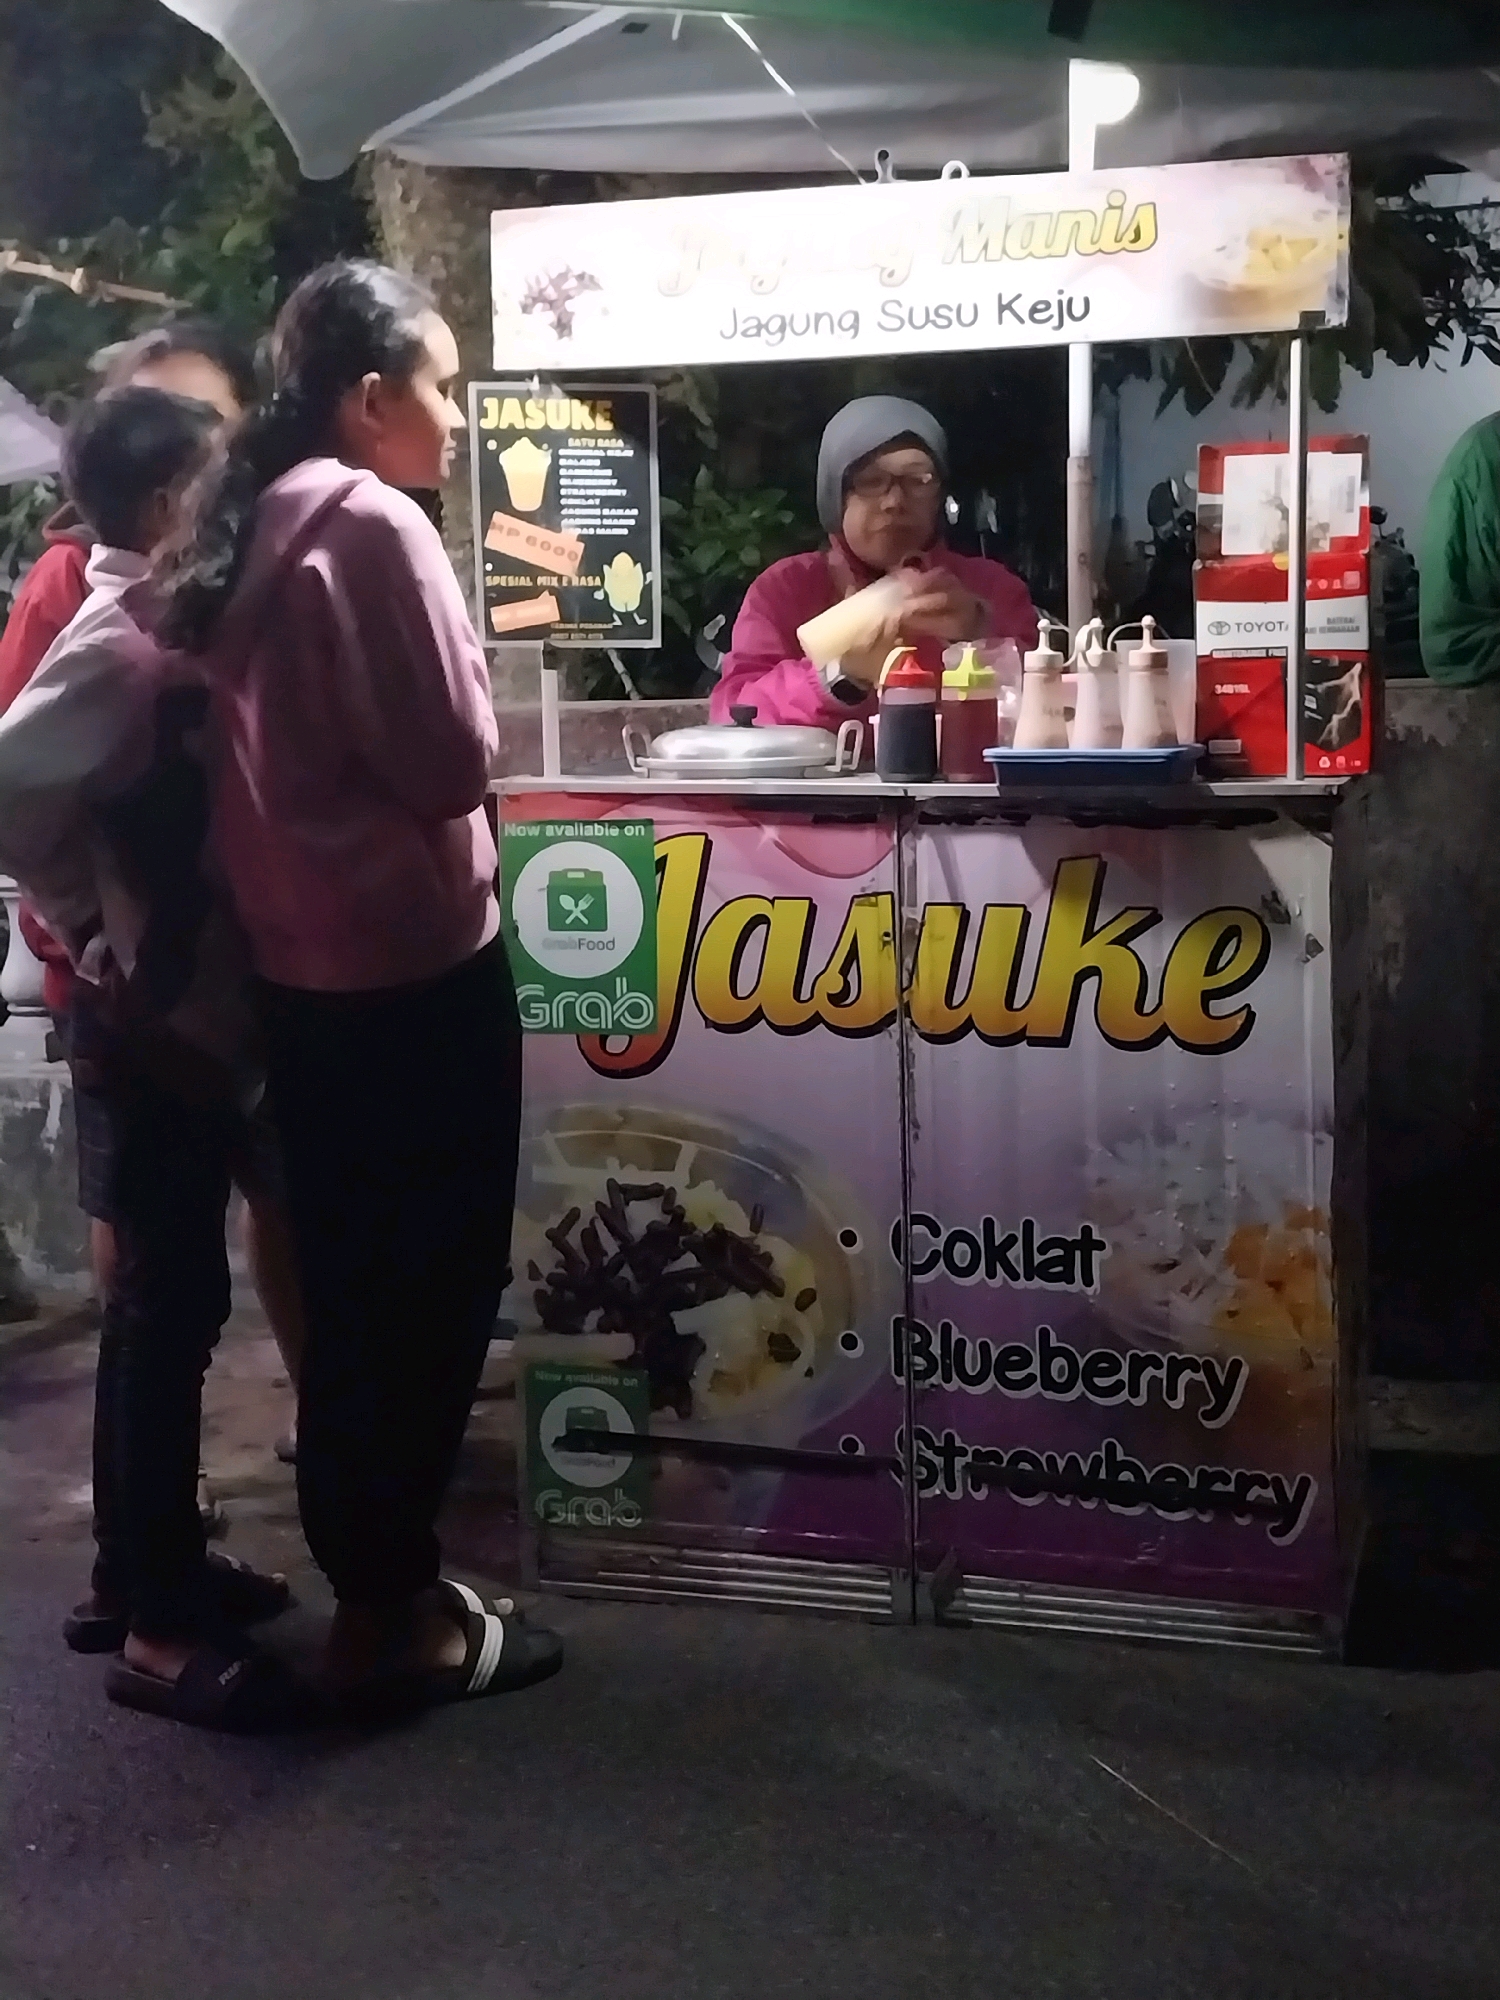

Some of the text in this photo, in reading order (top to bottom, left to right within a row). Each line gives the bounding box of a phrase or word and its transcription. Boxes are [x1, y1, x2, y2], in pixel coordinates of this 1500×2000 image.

[941, 188, 1159, 265] Manis
[720, 288, 1092, 347] Jagung Susu Keju
[480, 396, 614, 431] JASUKE
[485, 575, 533, 587] SPESIAL
[1234, 620, 1289, 634] TOYOT
[504, 822, 645, 837] Now available on
[575, 832, 1272, 1080] Jasuke
[516, 976, 655, 1030] Grab
[890, 1213, 1109, 1292] Coklat
[890, 1315, 1248, 1428] Blueberry
[535, 1487, 642, 1528] Grab
